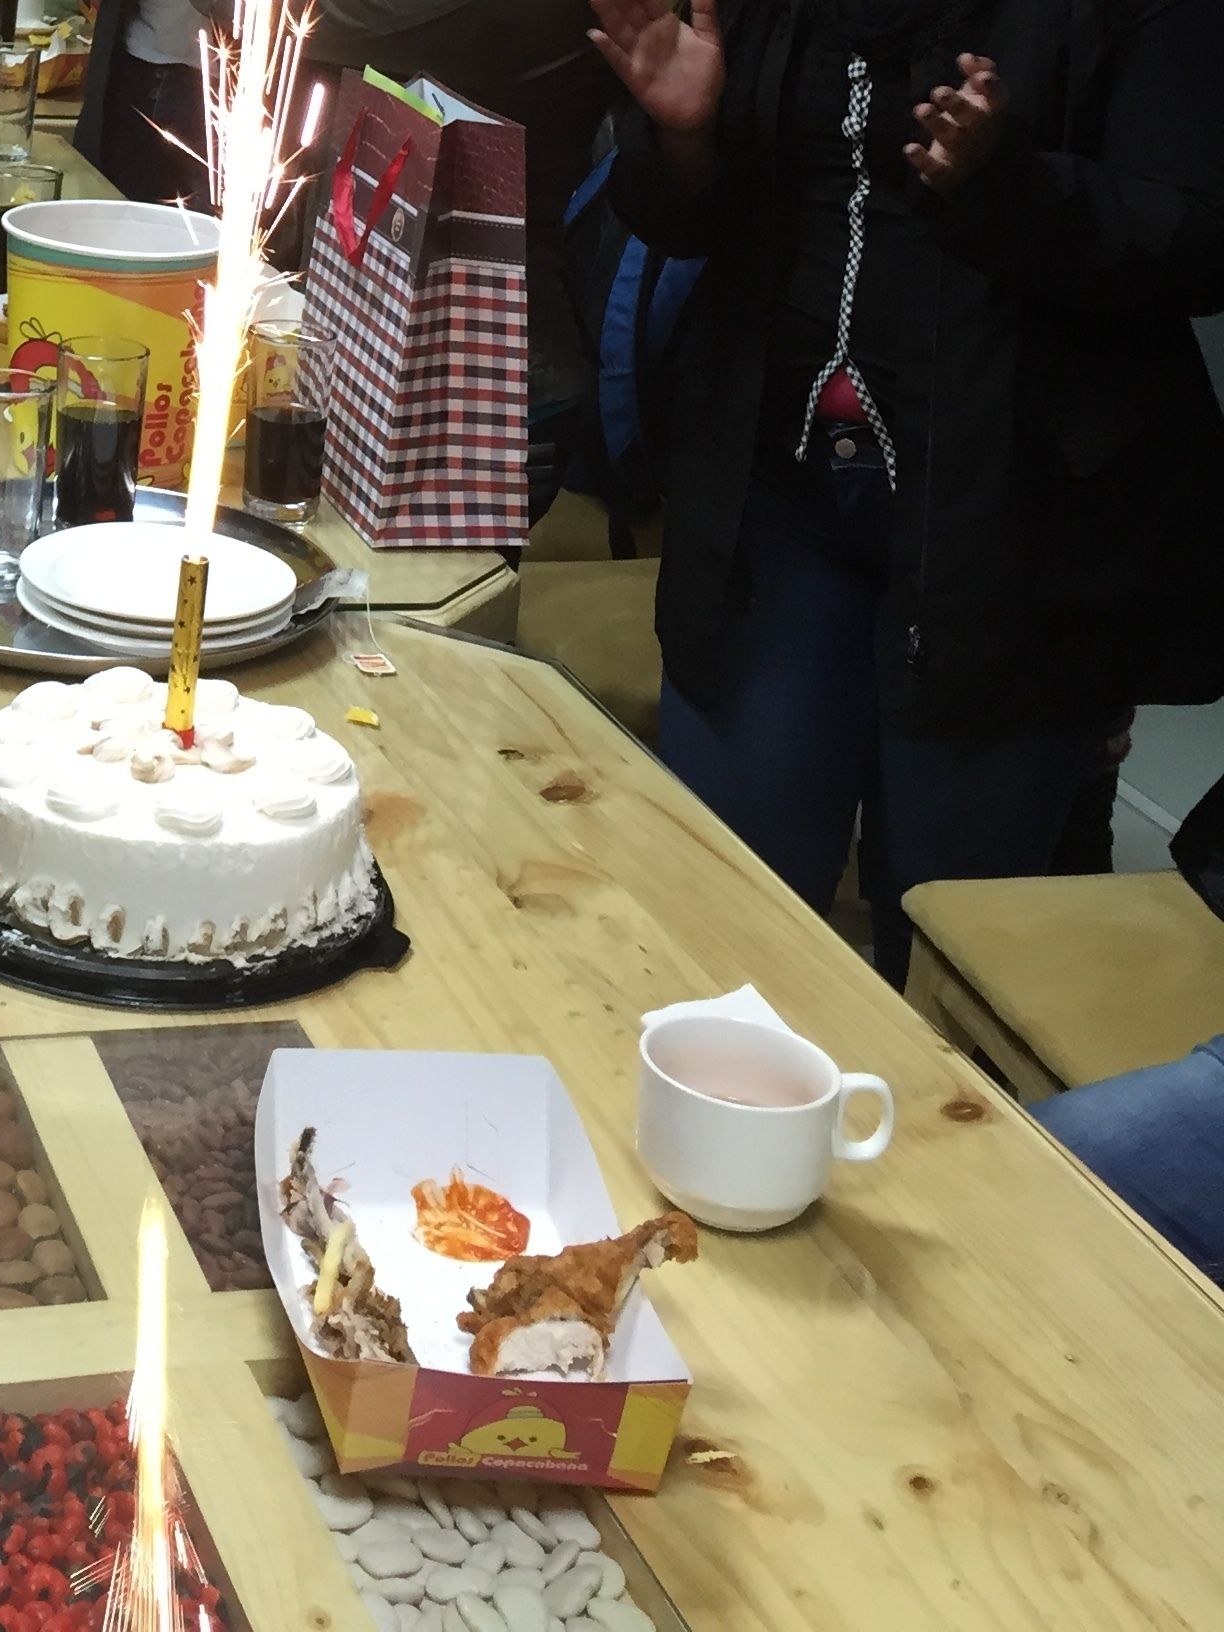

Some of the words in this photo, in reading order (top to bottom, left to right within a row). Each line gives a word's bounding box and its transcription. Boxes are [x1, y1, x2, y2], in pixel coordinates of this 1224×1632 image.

[138, 382, 173, 466] Pollos
[422, 1450, 475, 1466] Pollos
[481, 1456, 589, 1471] Copacabana
